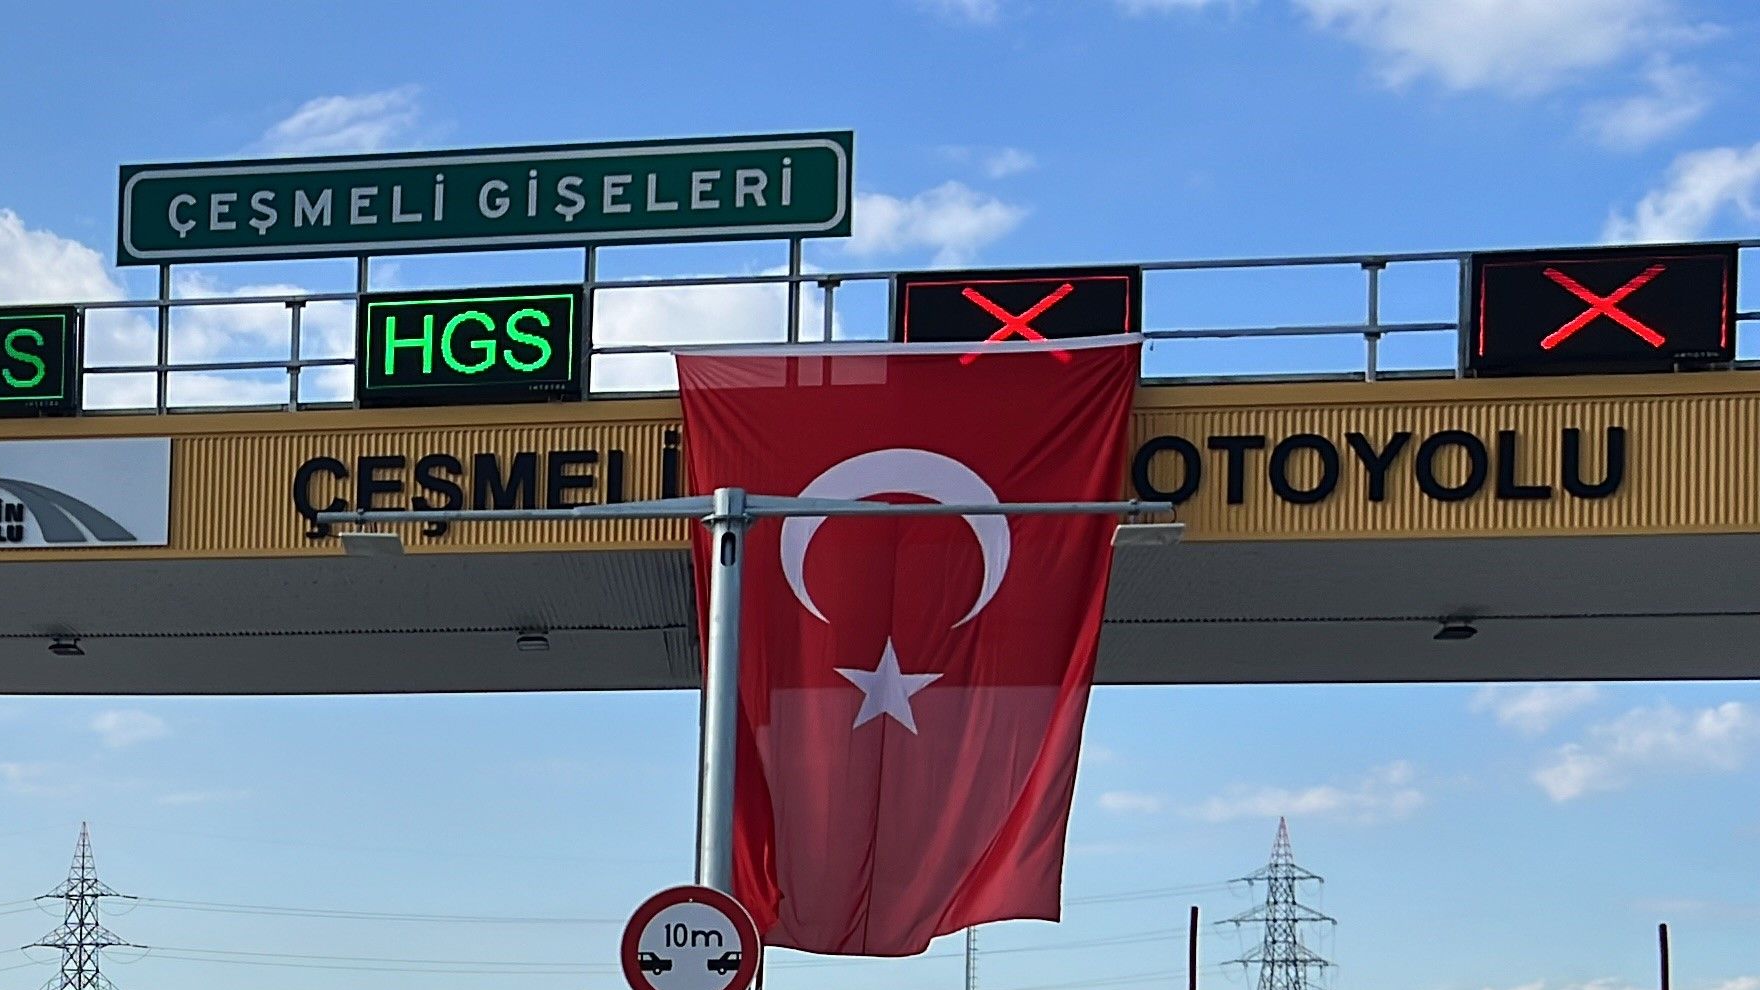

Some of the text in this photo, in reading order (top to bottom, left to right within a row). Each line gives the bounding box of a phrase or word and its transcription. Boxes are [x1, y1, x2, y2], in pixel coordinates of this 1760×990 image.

[168, 157, 792, 238] ÇEŞMELİ GİŞELERİ
[384, 308, 552, 375] HGS
[293, 426, 1625, 538] ÇEŞMELİ OTOYOLU
[664, 922, 723, 948] 10m
